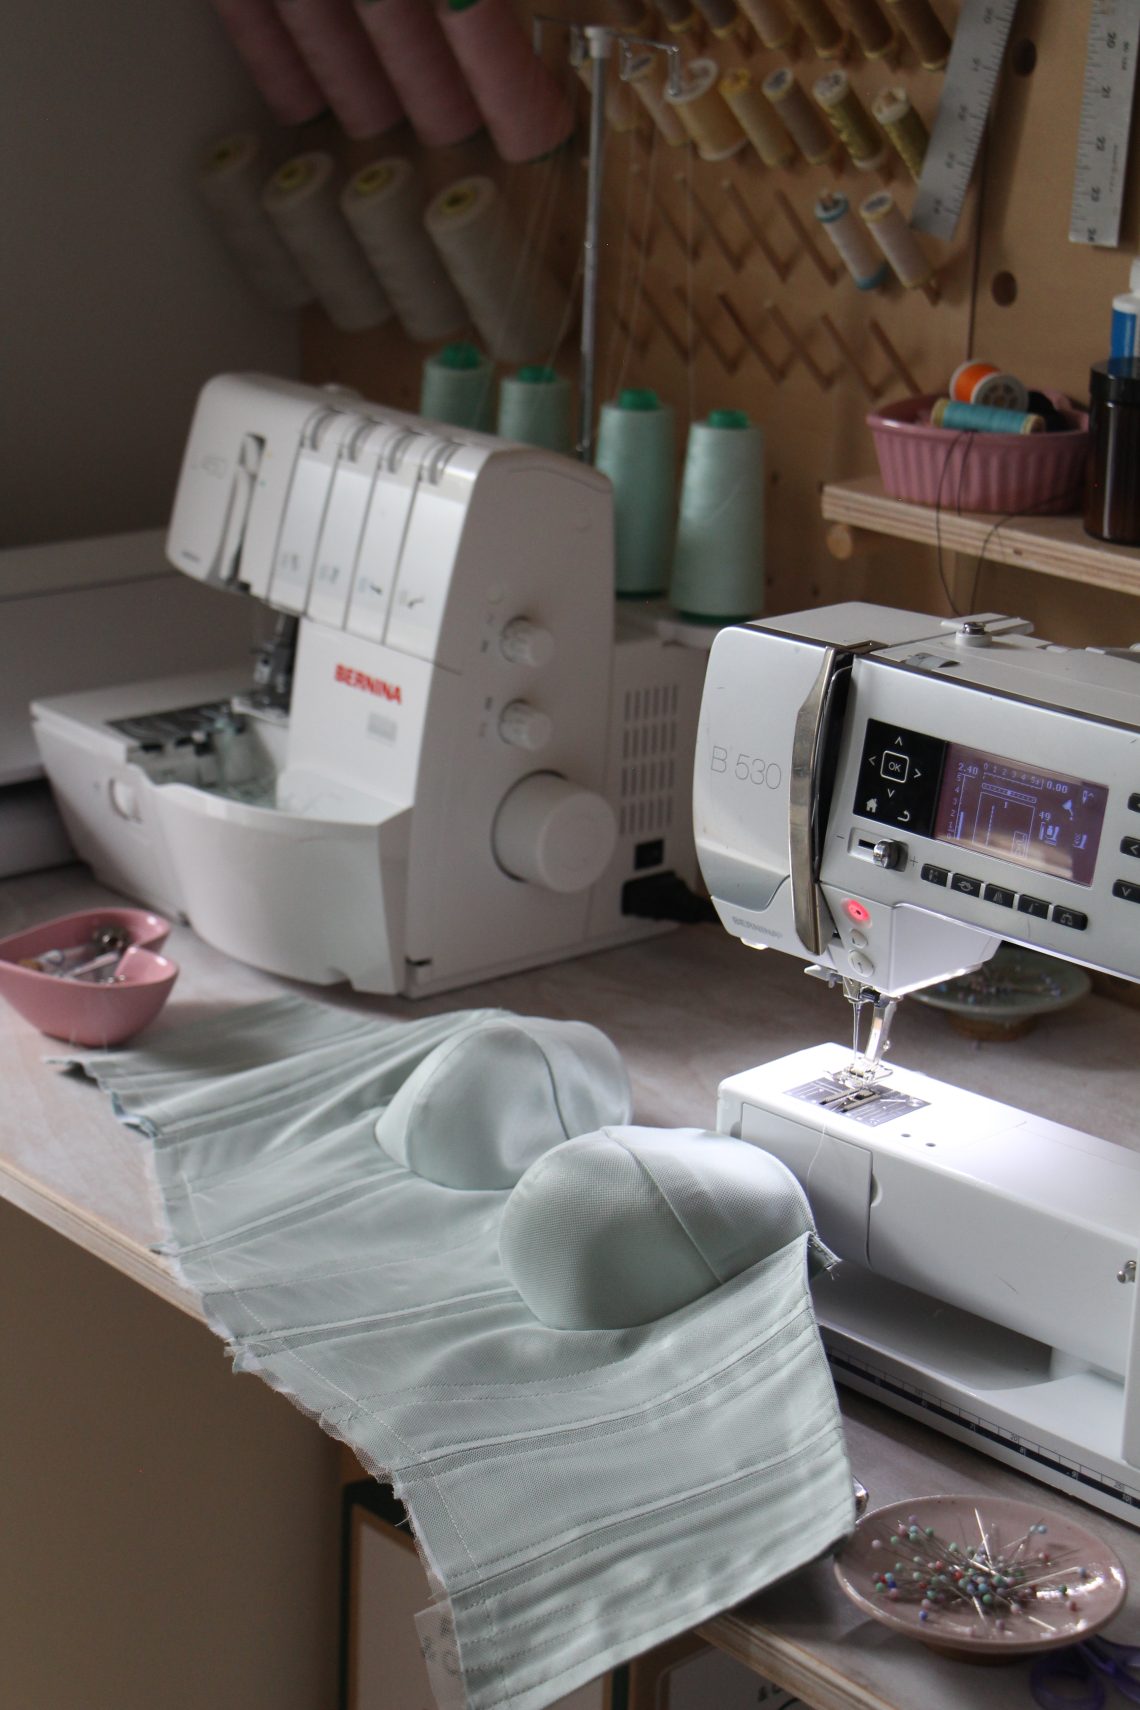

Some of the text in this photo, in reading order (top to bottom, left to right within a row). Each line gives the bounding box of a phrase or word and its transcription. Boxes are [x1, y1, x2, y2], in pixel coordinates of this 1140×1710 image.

[1105, 31, 1116, 49] 20
[334, 664, 403, 704] BERNINA
[710, 745, 782, 790] B 530
[888, 761, 902, 773] OK
[958, 761, 979, 775] 2.40
[1046, 780, 1069, 794] 0.00
